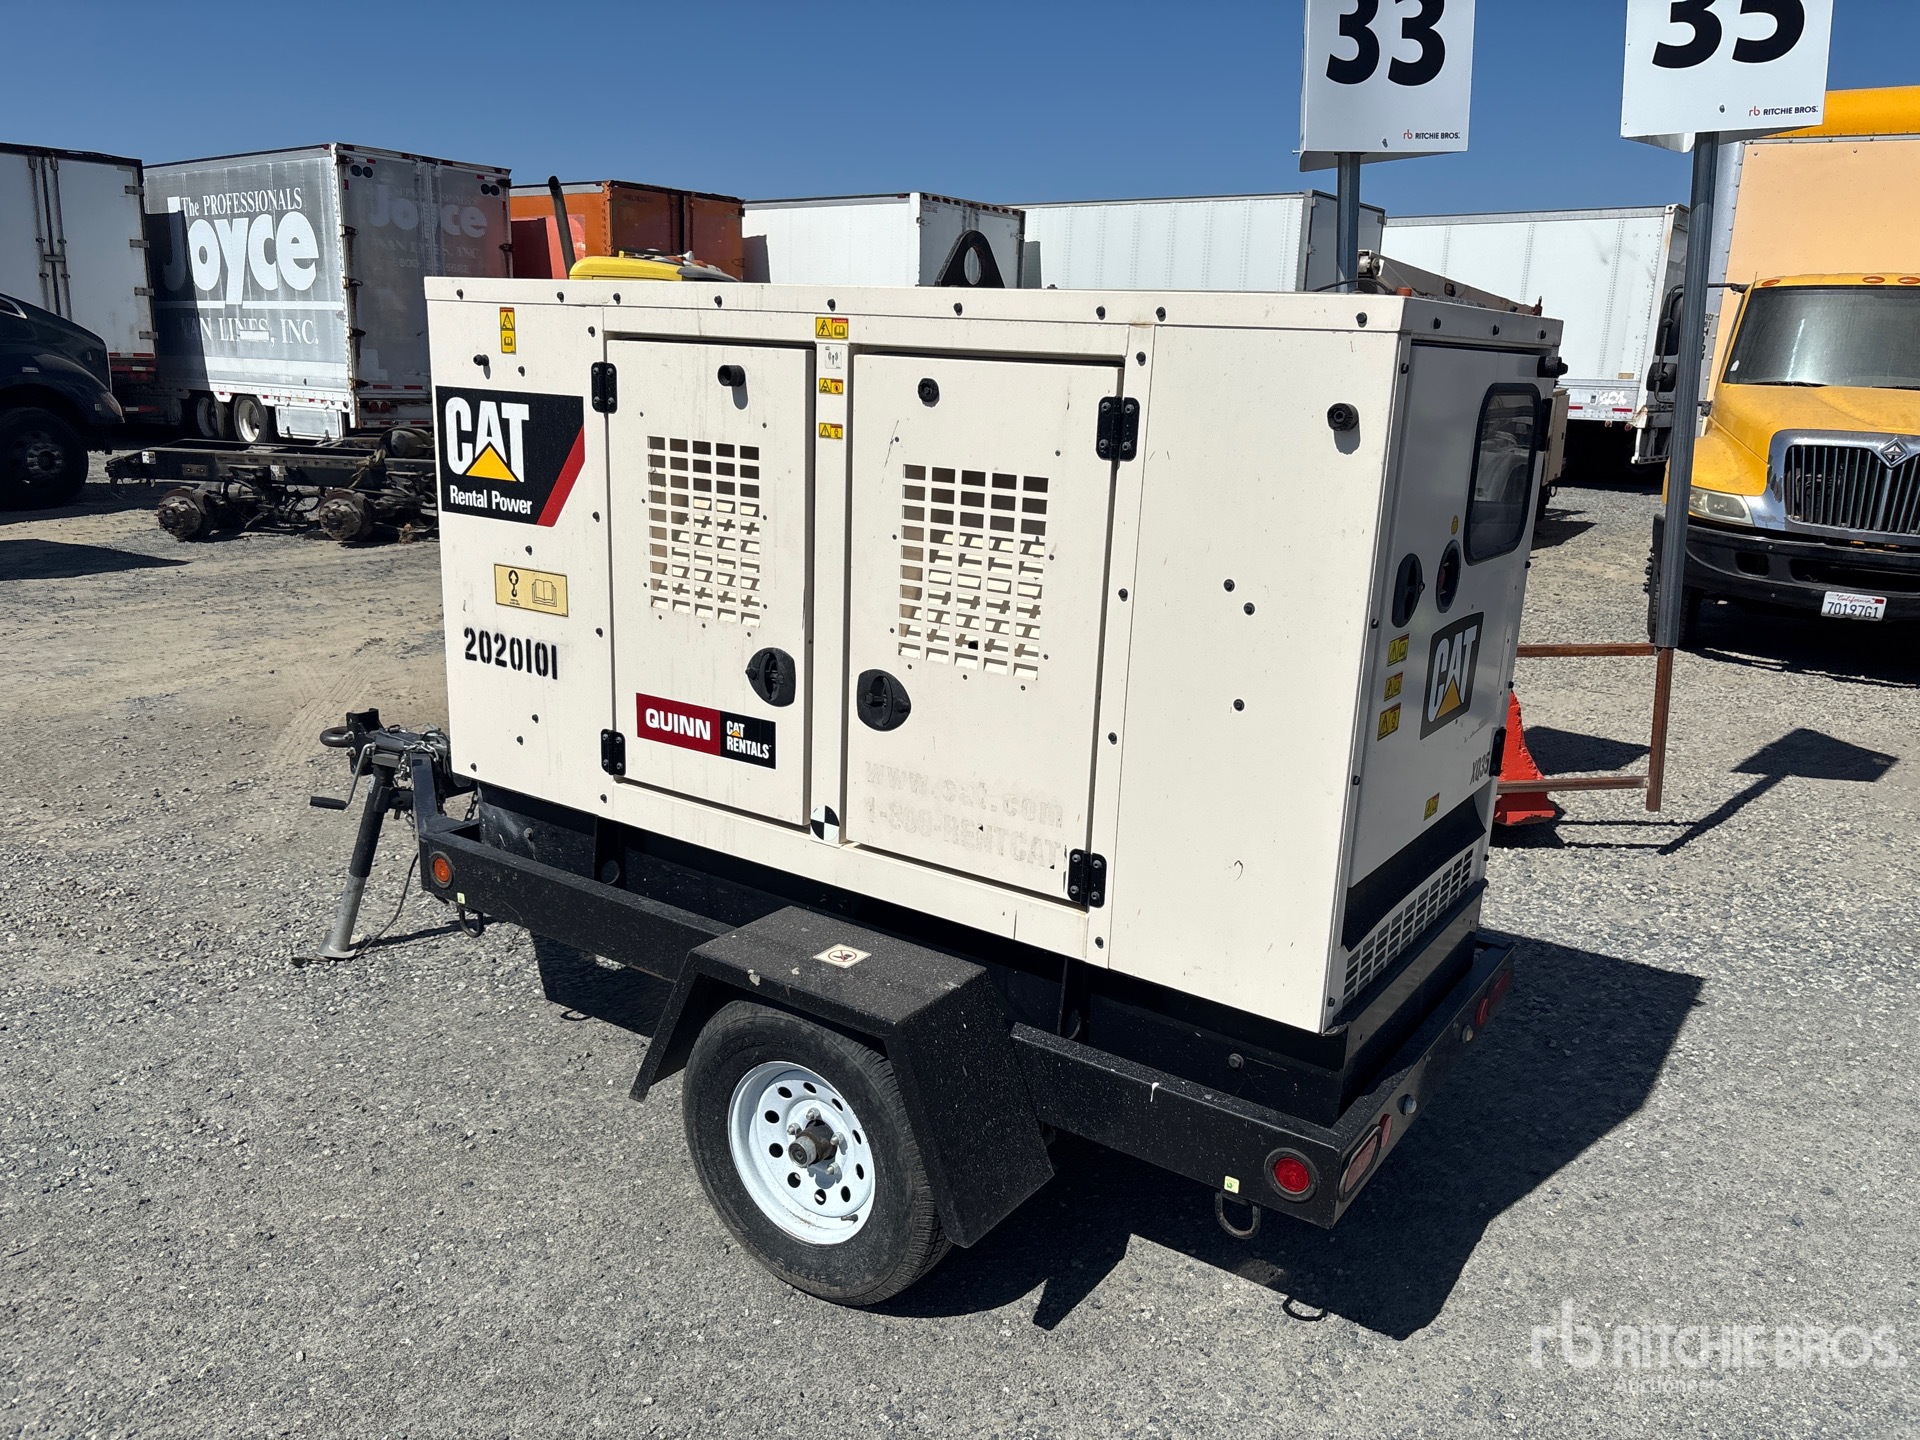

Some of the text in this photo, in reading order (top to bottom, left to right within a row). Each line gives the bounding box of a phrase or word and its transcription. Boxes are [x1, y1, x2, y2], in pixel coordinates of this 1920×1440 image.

[1326, 0, 1446, 86] 33
[1652, 0, 1805, 69] 35
[1763, 107, 1793, 116] RITCHIE
[1794, 105, 1819, 114] BROS.
[1415, 132, 1440, 140] RITCHIE
[1440, 132, 1461, 140] BROS.
[181, 187, 303, 217] The PROFESSIONALS
[163, 196, 319, 305] Joyce
[280, 319, 319, 345] INC.
[445, 396, 530, 483] CAT
[449, 484, 533, 515] Rental Power
[1827, 601, 1879, 618] 70197G1
[1427, 625, 1478, 722] CAT
[645, 707, 711, 741] QUINN
[726, 720, 745, 738] CAT
[726, 735, 770, 760] RENTALS
